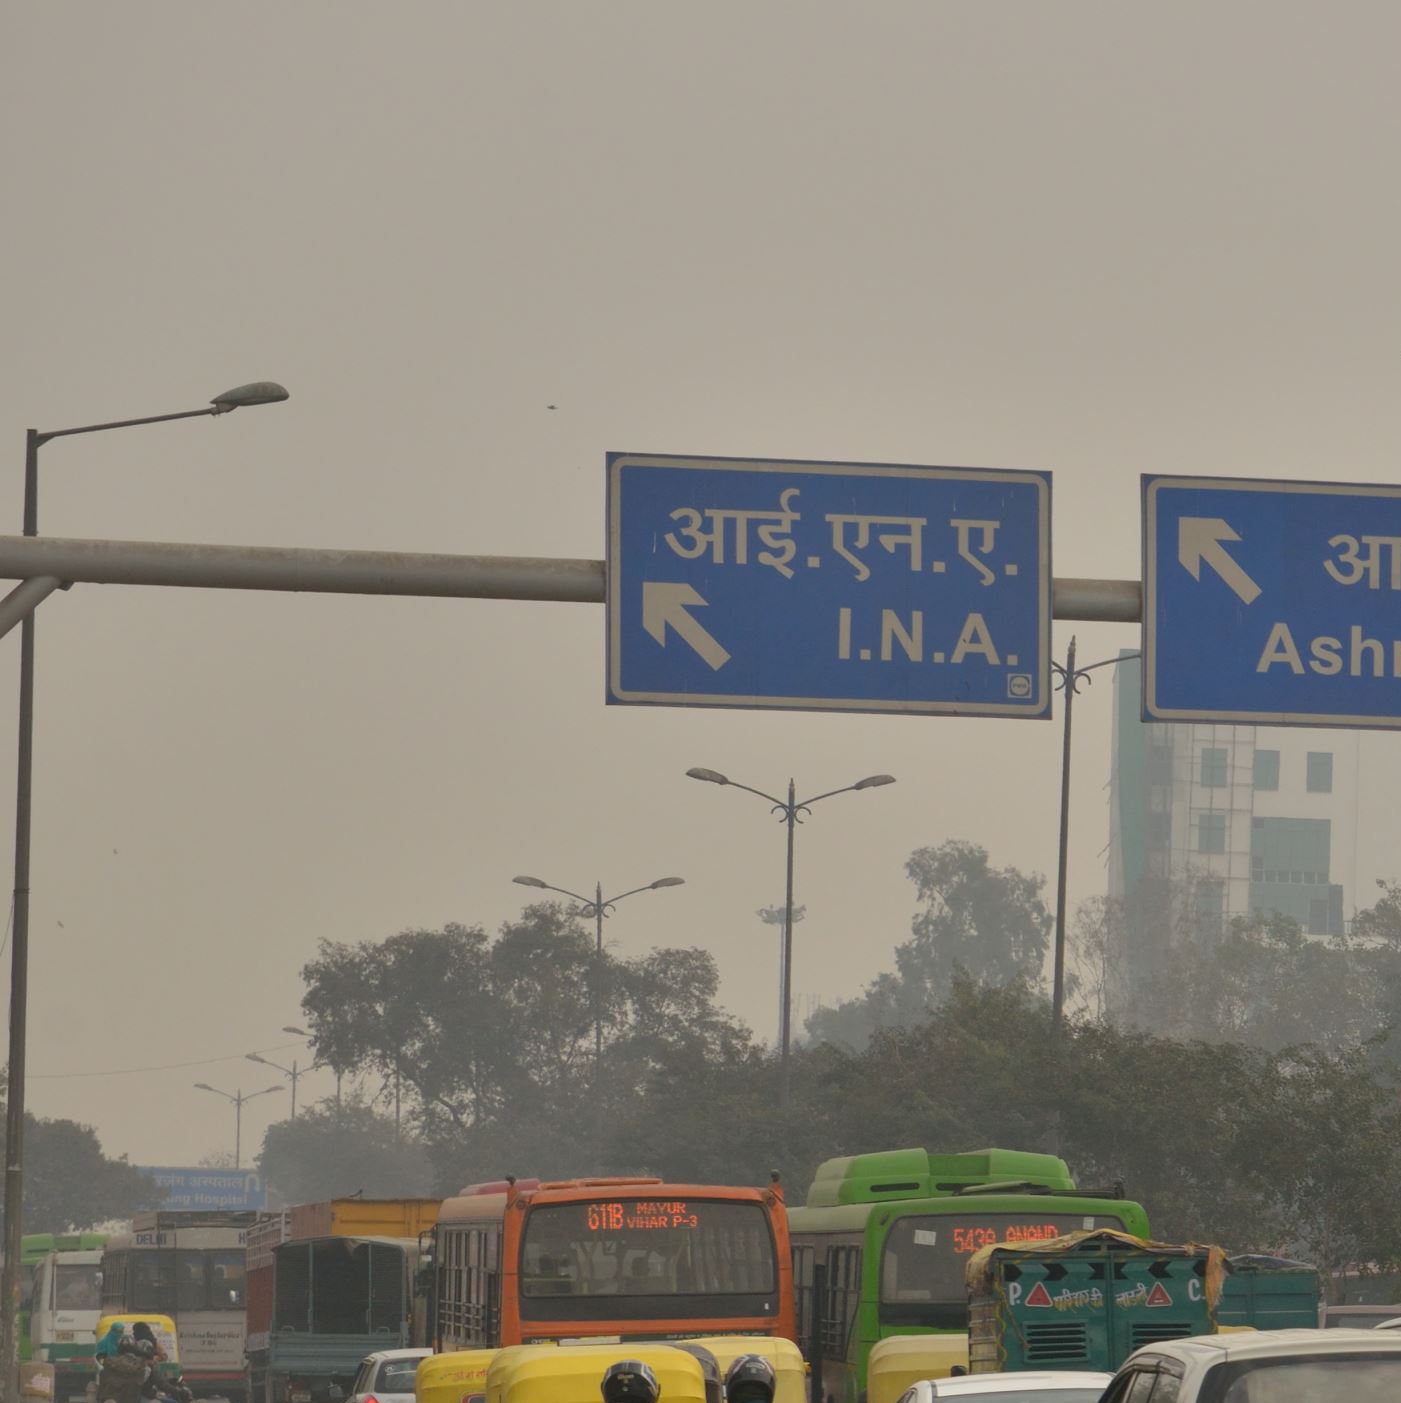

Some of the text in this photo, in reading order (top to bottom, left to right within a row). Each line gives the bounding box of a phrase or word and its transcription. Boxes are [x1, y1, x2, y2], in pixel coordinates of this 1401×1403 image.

[663, 488, 1018, 587] आई.एन.ए.
[838, 607, 1018, 666] I.N.A.
[194, 1193, 248, 1207] Hospital
[636, 1202, 686, 1215] MAYUR
[626, 1214, 698, 1229] VIHAR P-3
[136, 1233, 167, 1245] DELHI
